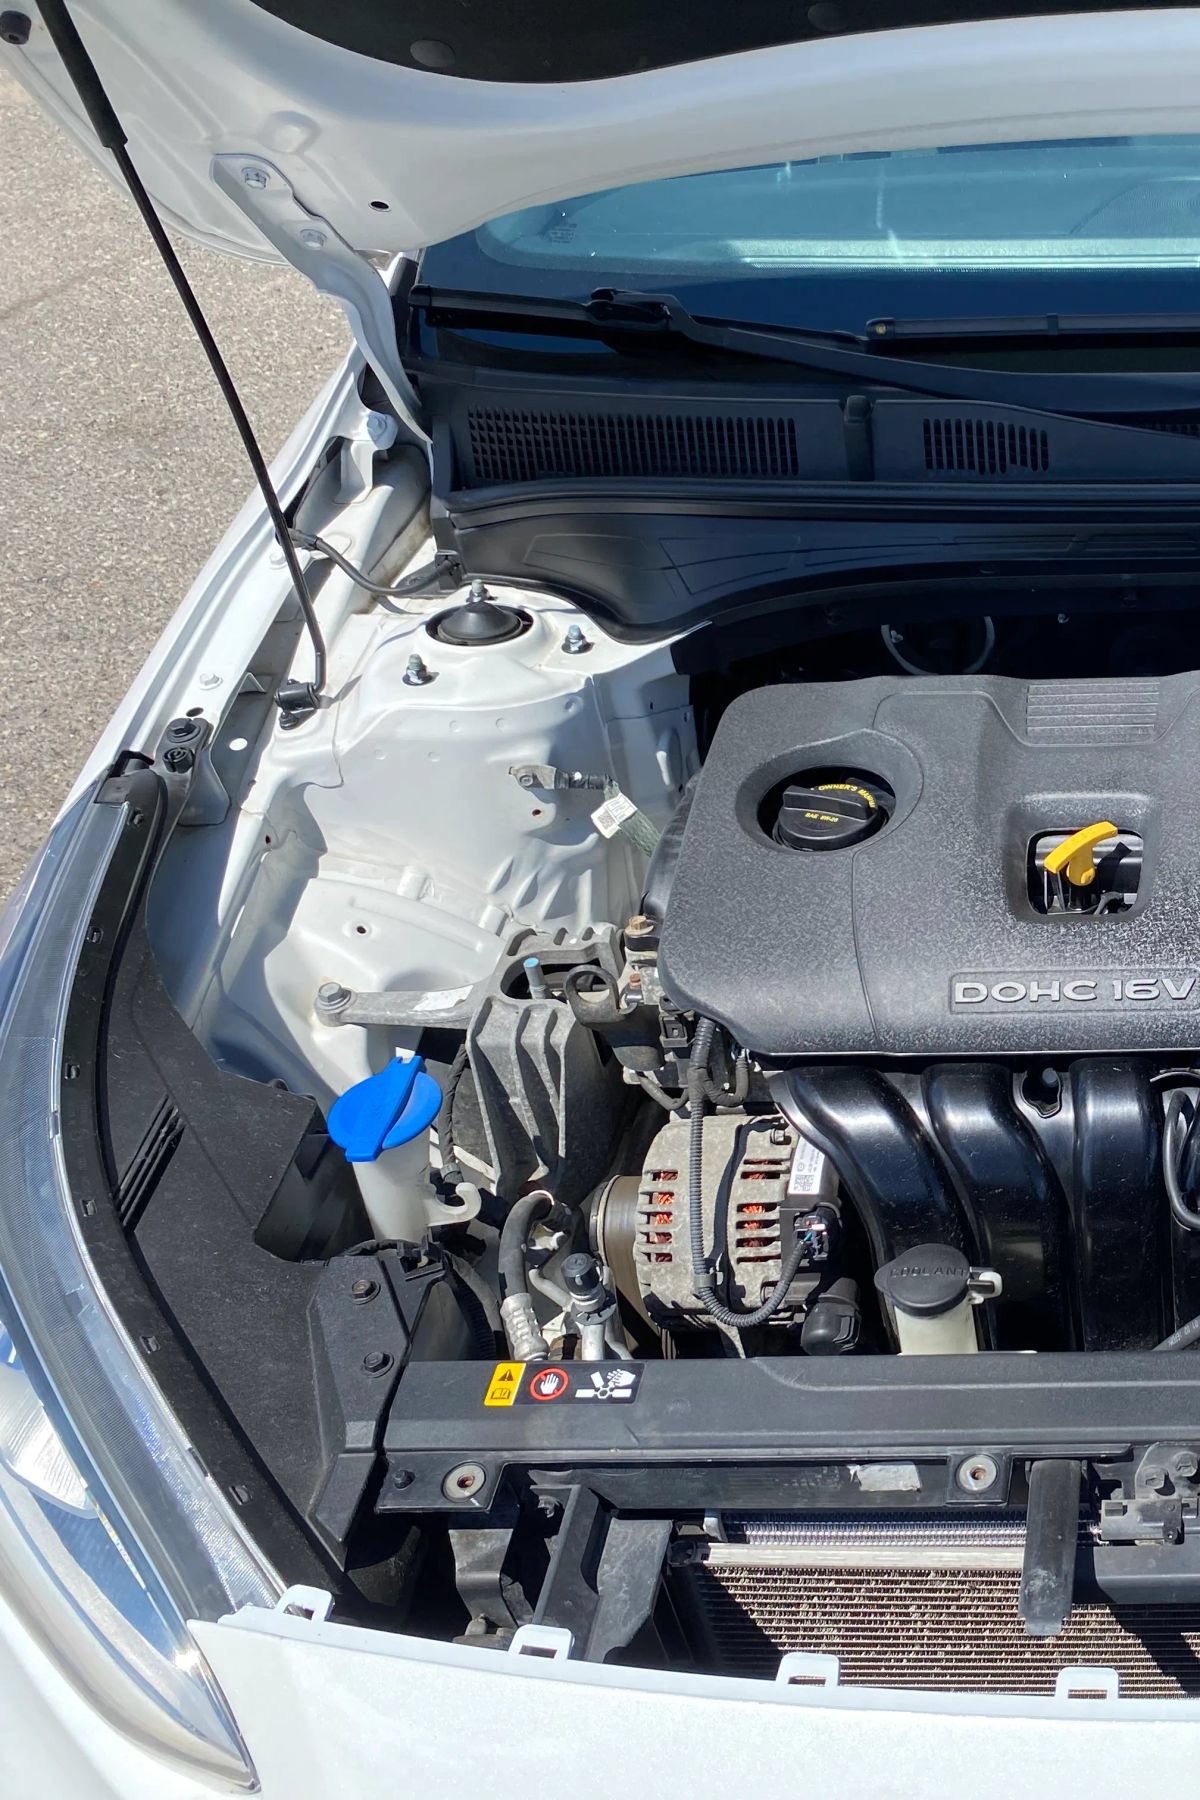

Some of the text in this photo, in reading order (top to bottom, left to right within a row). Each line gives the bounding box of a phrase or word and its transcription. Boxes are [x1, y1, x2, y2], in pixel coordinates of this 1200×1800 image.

[818, 783, 858, 792] OWNER'S
[954, 978, 1197, 1004] DOHC 16V
[889, 1266, 968, 1278] COOLANT
